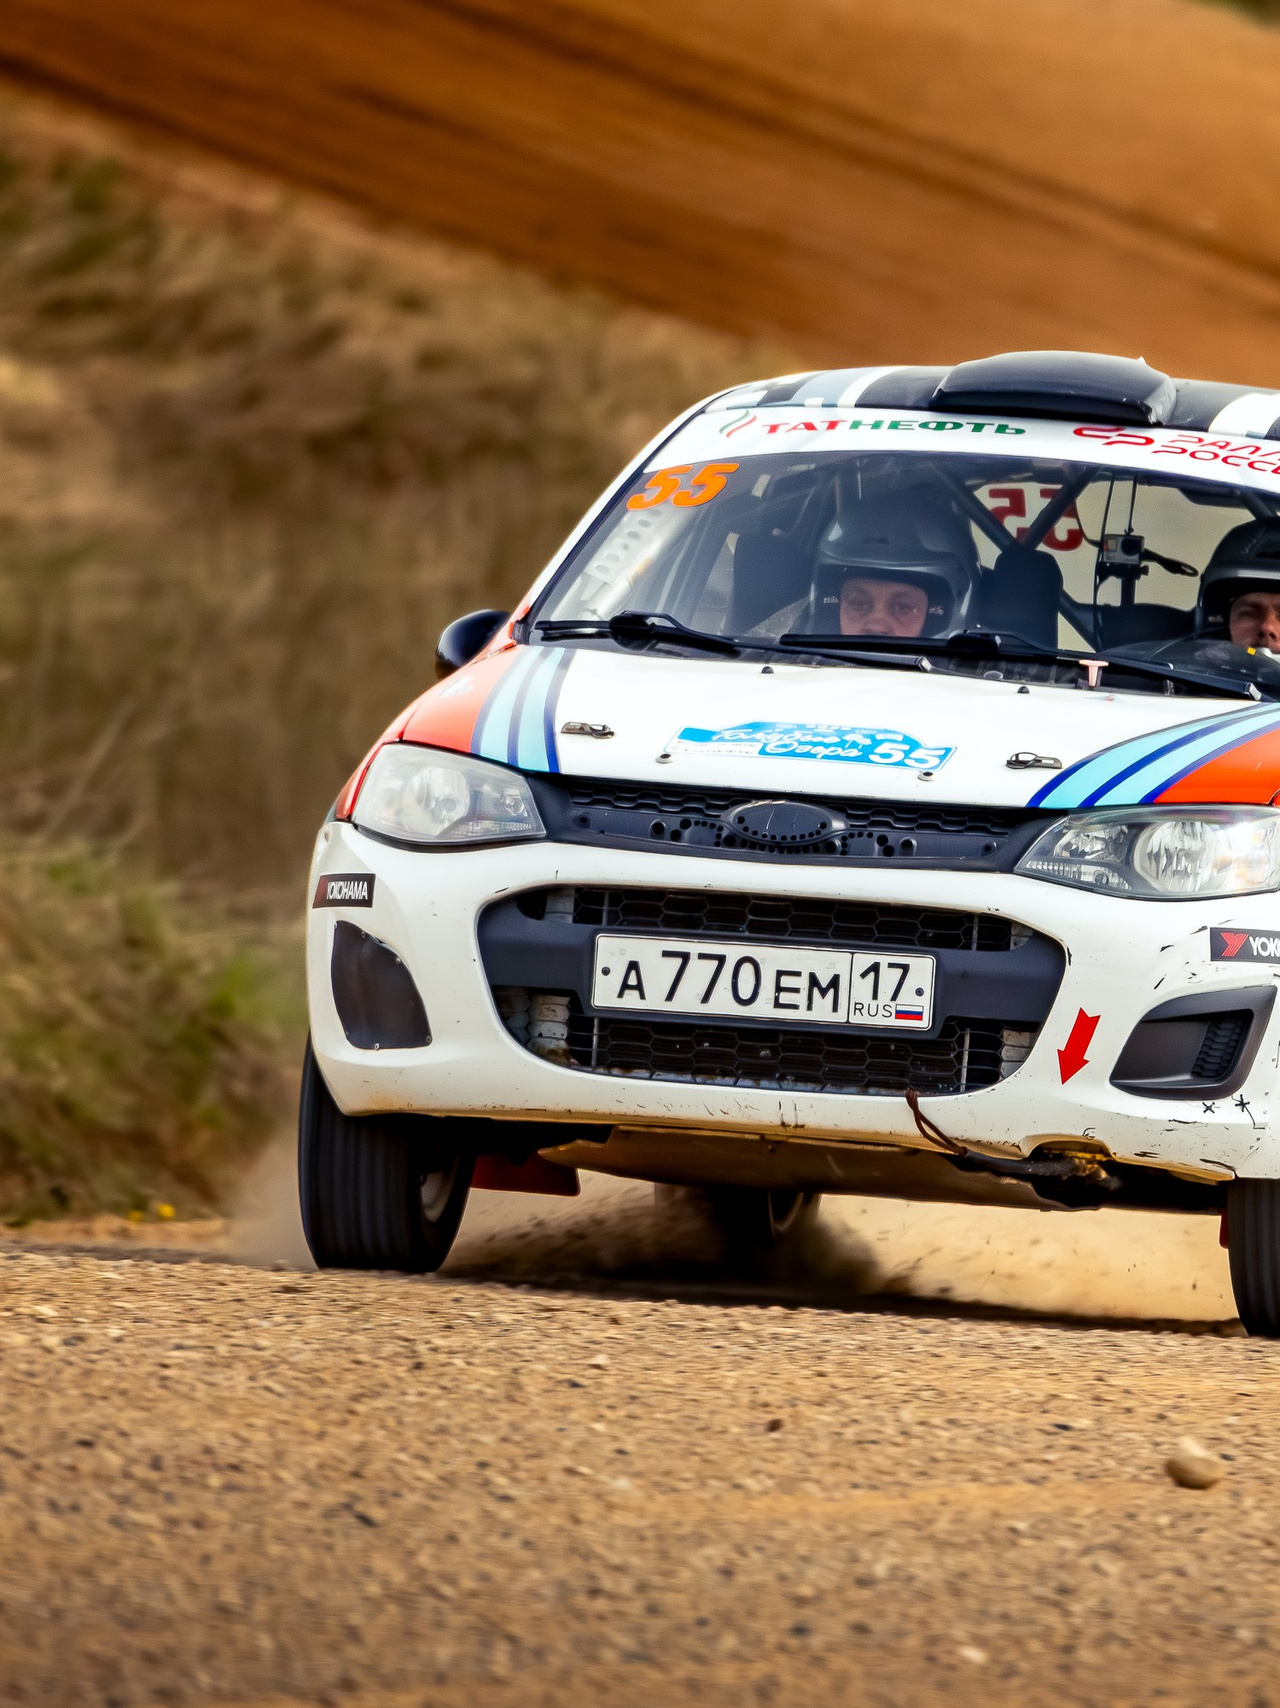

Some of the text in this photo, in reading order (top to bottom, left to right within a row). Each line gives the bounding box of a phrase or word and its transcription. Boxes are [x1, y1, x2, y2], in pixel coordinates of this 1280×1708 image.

[762, 418, 1027, 435] ТАТНЕФТЬ
[626, 462, 740, 511] 55
[868, 742, 947, 769] 55
[860, 962, 911, 1002] 17
[853, 1002, 893, 1019] RUS
